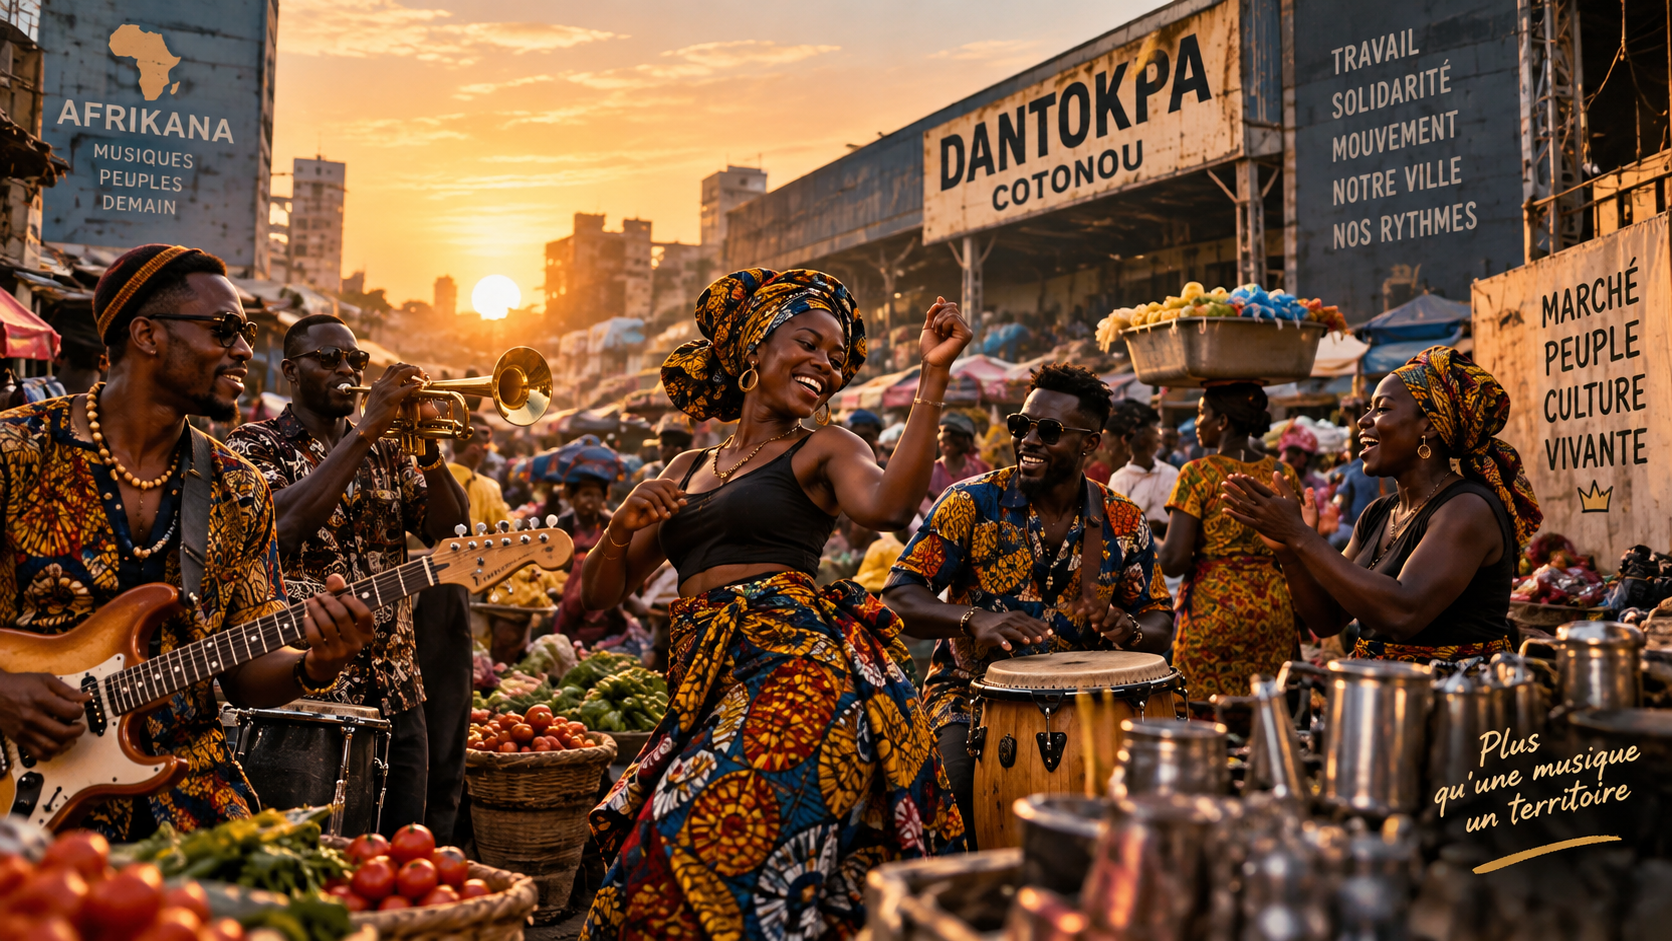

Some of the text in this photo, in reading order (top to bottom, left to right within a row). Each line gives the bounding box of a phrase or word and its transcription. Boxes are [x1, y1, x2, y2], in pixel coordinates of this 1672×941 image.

[1331, 28, 1419, 75] TRAVAIL
[940, 33, 1212, 191] DANTOKPA
[1332, 59, 1451, 119] SOLIDARITÉ
[57, 99, 234, 144] AFRIKANA
[1332, 110, 1458, 162] MOUVEMENT
[94, 144, 193, 169] MUSIQUES
[100, 169, 182, 192] PEUPLES
[992, 140, 1143, 211] COTONOU
[1333, 156, 1462, 206] NOTRE VILLE
[102, 195, 176, 215] DEMAIN
[1333, 201, 1478, 249] NOS RYTHMES
[1542, 257, 1640, 328] MARCHÉ
[1544, 319, 1640, 376] PEUPLE
[1544, 373, 1647, 423] CULTURE
[1545, 427, 1648, 471] VIVANTE
